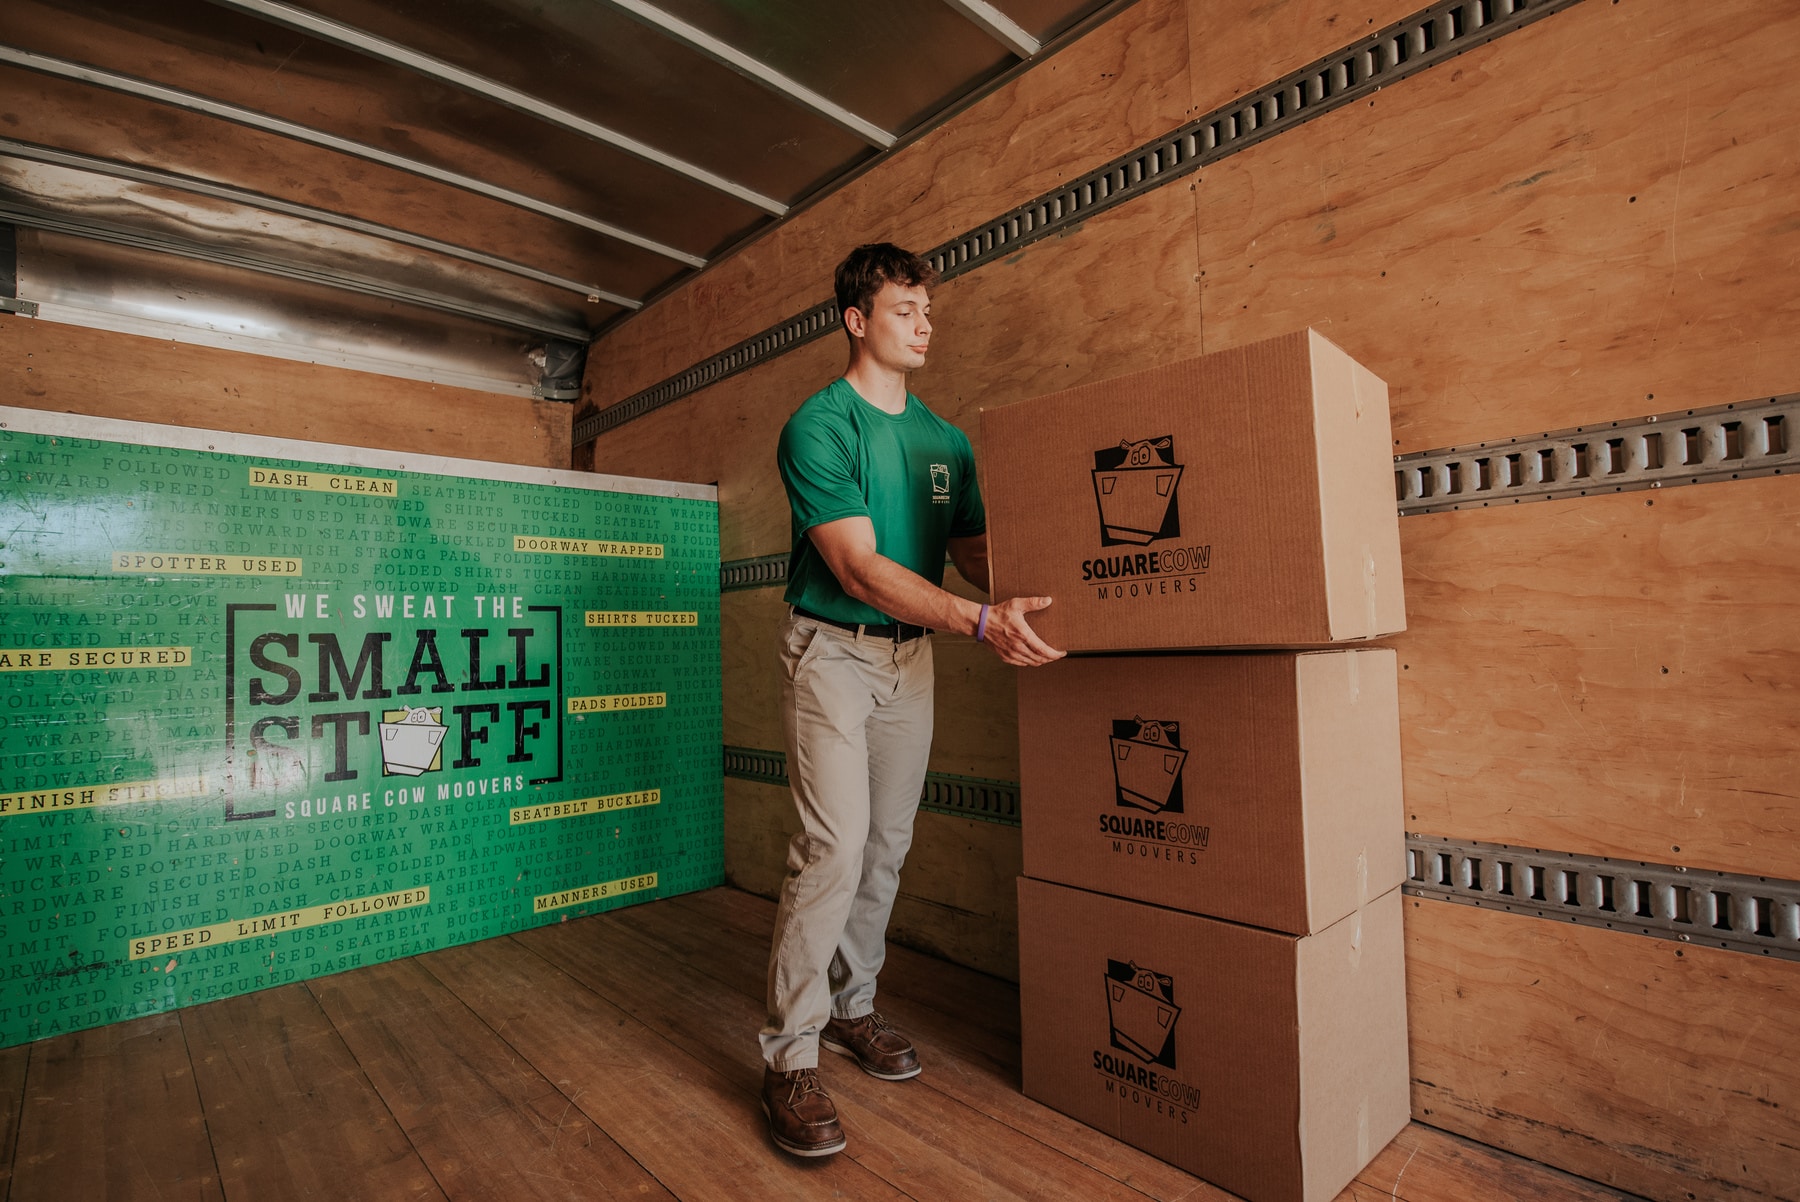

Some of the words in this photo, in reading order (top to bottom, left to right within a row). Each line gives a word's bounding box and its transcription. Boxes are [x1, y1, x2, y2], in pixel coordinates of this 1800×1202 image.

[102, 456, 230, 480] FOLLOWED
[254, 471, 309, 487] DASH
[330, 478, 392, 493] CLEAN
[412, 485, 496, 502] SEATBELT
[513, 494, 580, 509] BUCKLED
[595, 501, 658, 515] DOORWAY
[140, 479, 214, 497] SPEED
[240, 487, 302, 504] LIMIT
[324, 494, 425, 513] FOLLOWED
[444, 503, 503, 518] SHIRTS
[521, 509, 580, 523] TUCKED
[595, 515, 661, 529] SEATBELT
[170, 501, 279, 519] MANNERS
[292, 509, 344, 523] USED
[355, 513, 457, 530] HARDWARE
[467, 520, 541, 535] SECURED
[549, 526, 587, 538] DASH
[594, 530, 639, 541] CLEAN
[646, 534, 677, 545] PADS
[204, 522, 307, 538] FORWARD
[322, 529, 417, 544] SEATBELT
[430, 533, 506, 548] BUCKLED
[517, 540, 588, 552] DOORWAY
[599, 543, 662, 556] WRAPPED
[269, 542, 339, 557] FINISH
[355, 546, 426, 560] STRONG
[440, 550, 481, 562] PADS
[494, 552, 552, 565] FOLDED
[563, 555, 608, 567] SPEED
[619, 558, 655, 569] LIMIT
[1082, 545, 1211, 581] SQUARECOW
[120, 555, 227, 571] SPOTTER
[242, 559, 297, 572] USED
[312, 561, 360, 574] PADS
[373, 563, 442, 577] FOLDED
[454, 566, 513, 579] SHIRTS
[523, 568, 581, 581] TUCKED
[592, 571, 665, 584] HARDWARE
[285, 579, 343, 592] LIMIT
[362, 580, 460, 593] FOLLOWED
[477, 582, 518, 594] DASH
[534, 583, 582, 596] CLEAN
[596, 586, 663, 598] SEATBELT
[1098, 578, 1197, 600] MOOVERS
[285, 594, 329, 618] WE
[353, 595, 455, 619] SWEAT
[474, 596, 523, 619] THE
[623, 600, 668, 610] SHIRTS
[32, 612, 158, 627] WRAPPED
[588, 614, 637, 625] SHIRTS
[646, 614, 696, 625] TUCKED
[120, 632, 181, 646] HATS
[590, 627, 654, 639] WRAPPED
[69, 650, 187, 668] SECURED
[594, 641, 665, 653] FOLLOWED
[250, 628, 550, 706] SMALL
[620, 654, 679, 666] SECURED
[54, 669, 176, 687] FORWARD
[593, 669, 657, 682] DOORWAY
[597, 682, 662, 695] SEATBELT
[572, 698, 606, 711] PADS
[614, 695, 664, 709] FOLDED
[601, 708, 664, 723] WRAPPED
[25, 730, 151, 747] WRAPPED
[618, 722, 656, 737] LIMIT
[596, 735, 670, 752] HARDWARE
[599, 750, 664, 766] SEATBELT
[625, 761, 670, 777] SHIRTS
[0, 789, 94, 812] FINISH
[285, 792, 371, 819] SQUARE
[385, 786, 425, 807] COW
[438, 776, 523, 801] MOOVERS
[24, 843, 152, 872] WRAPPED
[168, 825, 296, 853] HARDWARE
[307, 810, 398, 834] SECURED
[409, 804, 454, 821] DASH
[465, 795, 518, 813] CLEAN
[528, 788, 564, 805] PADS
[573, 782, 626, 798] FOLDED
[634, 771, 696, 790] MANNERS
[1099, 814, 1210, 847] SQUARECOW
[120, 851, 228, 879] SPOTTER
[245, 842, 299, 861] USED
[314, 827, 408, 851] DOORWAY
[420, 813, 502, 836] WRAPPED
[513, 801, 588, 822] SEATBELT
[597, 791, 659, 811] BUCKLED
[148, 866, 257, 894] SECURED
[278, 855, 331, 874] DASH
[350, 842, 413, 862] CLEAN
[430, 833, 472, 850] PADS
[487, 822, 547, 841] FOLDED
[560, 813, 606, 830] SPEED
[619, 806, 655, 820] LIMIT
[1112, 841, 1197, 865] MOOVERS
[28, 911, 97, 933] USED
[115, 893, 200, 919] FINISH
[216, 878, 301, 903] STRONG
[315, 867, 363, 886] PADS
[376, 854, 446, 876] FOLDED
[457, 838, 548, 862] HARDWARE
[557, 826, 622, 845] SECURED
[631, 815, 679, 832] SHIRTS
[97, 908, 229, 941] FOLLOWED
[253, 894, 307, 914] DASH
[330, 879, 393, 901] CLEAN
[413, 861, 498, 886] SEATBELT
[515, 846, 583, 868] BUCKLED
[598, 833, 662, 852] DOORWAY
[135, 930, 212, 955] SPEED
[238, 913, 301, 936] LIMIT
[323, 890, 427, 920] FOLLOWED
[445, 875, 505, 896] SHIRTS
[523, 861, 582, 881] TUCKED
[598, 846, 664, 867] SEATBELT
[24, 961, 151, 996] WRAPPED
[168, 935, 279, 966] MANNERS
[292, 922, 344, 943] USED
[355, 900, 459, 931] HARDWARE
[468, 885, 543, 909] SECURED
[551, 876, 589, 891] DASH
[597, 863, 642, 881] CLEAN
[650, 854, 681, 870] PADS
[133, 961, 240, 996] SPOTTER
[262, 946, 316, 968] USED
[336, 919, 429, 952] SEATBELT
[446, 902, 522, 930] BUCKLED
[537, 884, 608, 910] MANNERS
[619, 875, 654, 892] USED
[26, 994, 177, 1039] HARDWARE
[190, 968, 295, 1002] SECURED
[310, 953, 362, 975] DASH
[375, 934, 436, 961] CLEAN
[446, 923, 489, 945] PADS
[1093, 1050, 1201, 1110] SQUARECOW
[1105, 1079, 1188, 1124] MOOVERS
